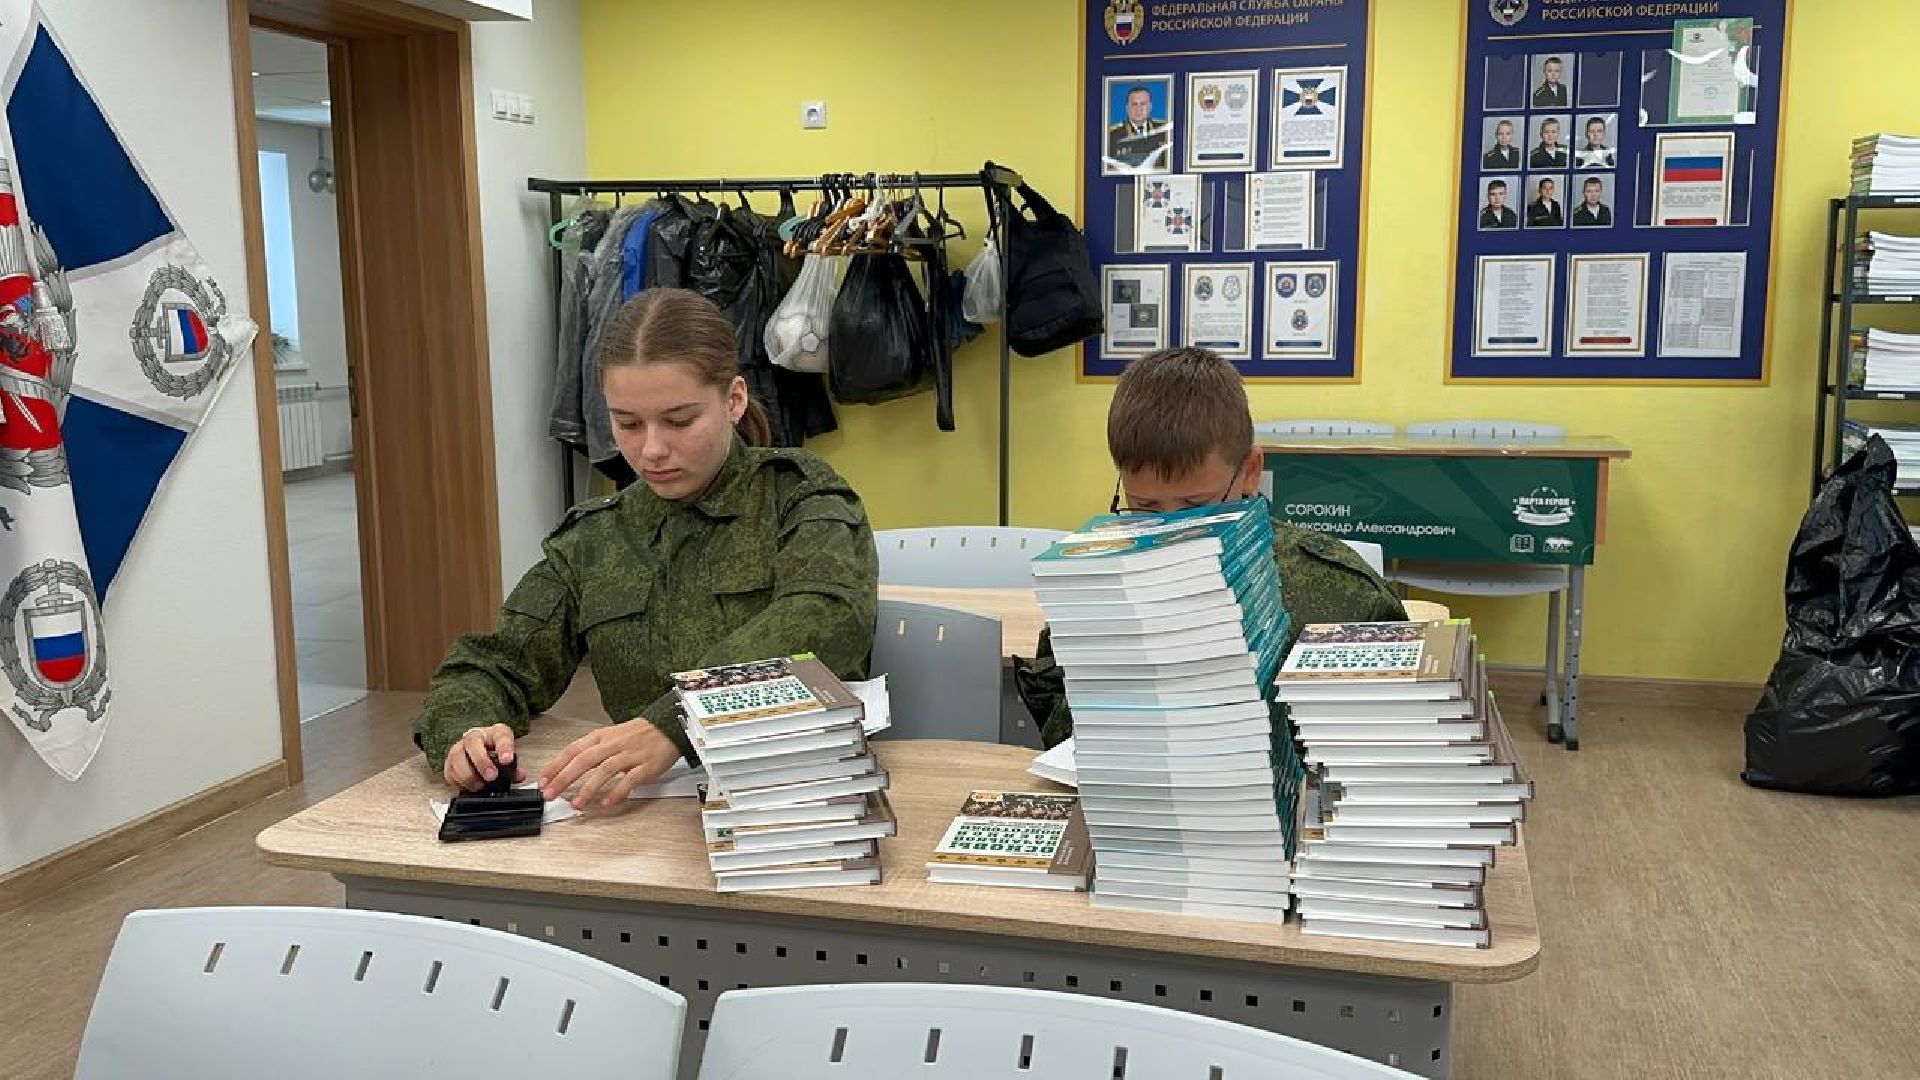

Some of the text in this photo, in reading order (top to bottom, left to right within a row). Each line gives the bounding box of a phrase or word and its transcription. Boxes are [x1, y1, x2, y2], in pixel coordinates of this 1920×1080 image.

[1152, 0, 1237, 16] ФЕДЕРАЛЬНАЯ
[1239, 0, 1290, 10] СЛУЖБА
[1542, 1, 1718, 20] РОССИЙСКОЙ ФЕДЕРАЦИИ
[1152, 12, 1309, 32] РОССИЙСКОЙ ФЕДЕРАЦИИ
[1285, 503, 1351, 517] СОРОКИН
[1286, 519, 1456, 538] ександр Александрович
